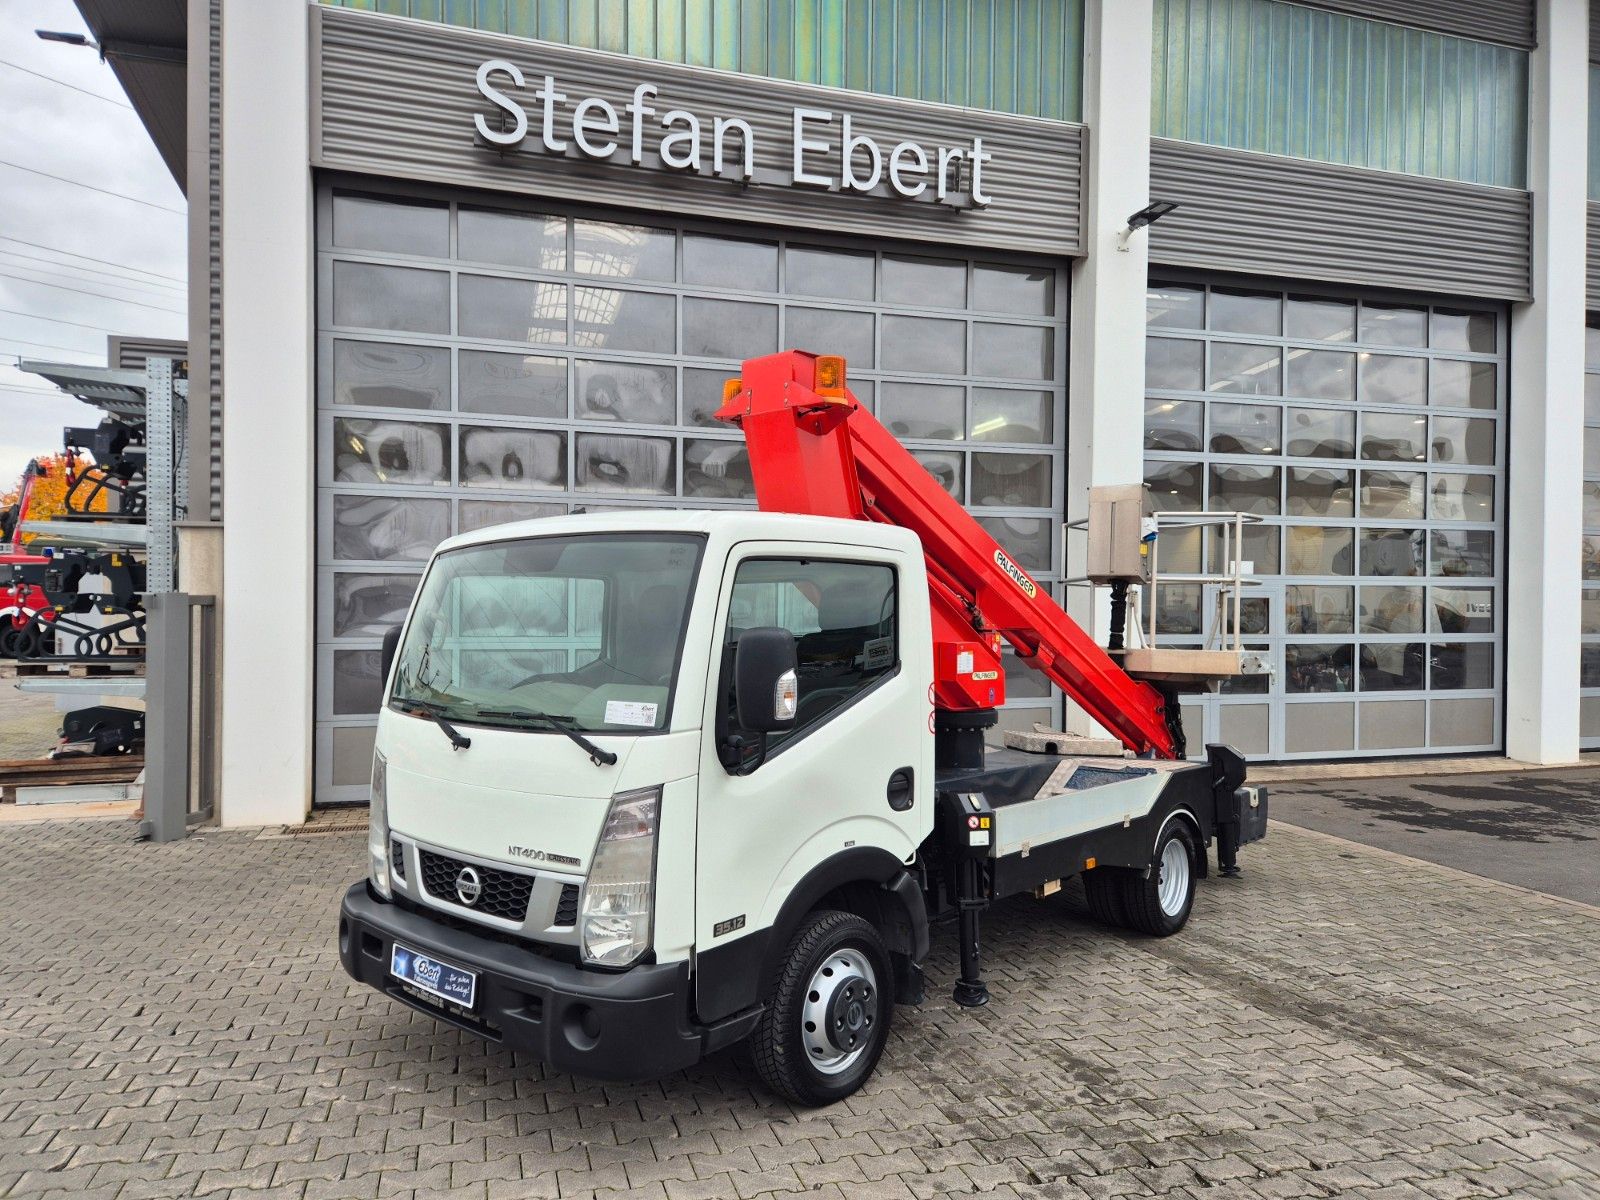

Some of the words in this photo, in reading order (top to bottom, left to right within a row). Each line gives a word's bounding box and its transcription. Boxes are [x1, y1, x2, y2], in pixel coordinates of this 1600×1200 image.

[473, 59, 754, 182] Stefan
[792, 107, 992, 208] Ebert
[996, 551, 1035, 596] PALFINGER
[508, 845, 546, 861] NT400
[715, 915, 745, 936] 35.12
[418, 960, 440, 980] Ebert
